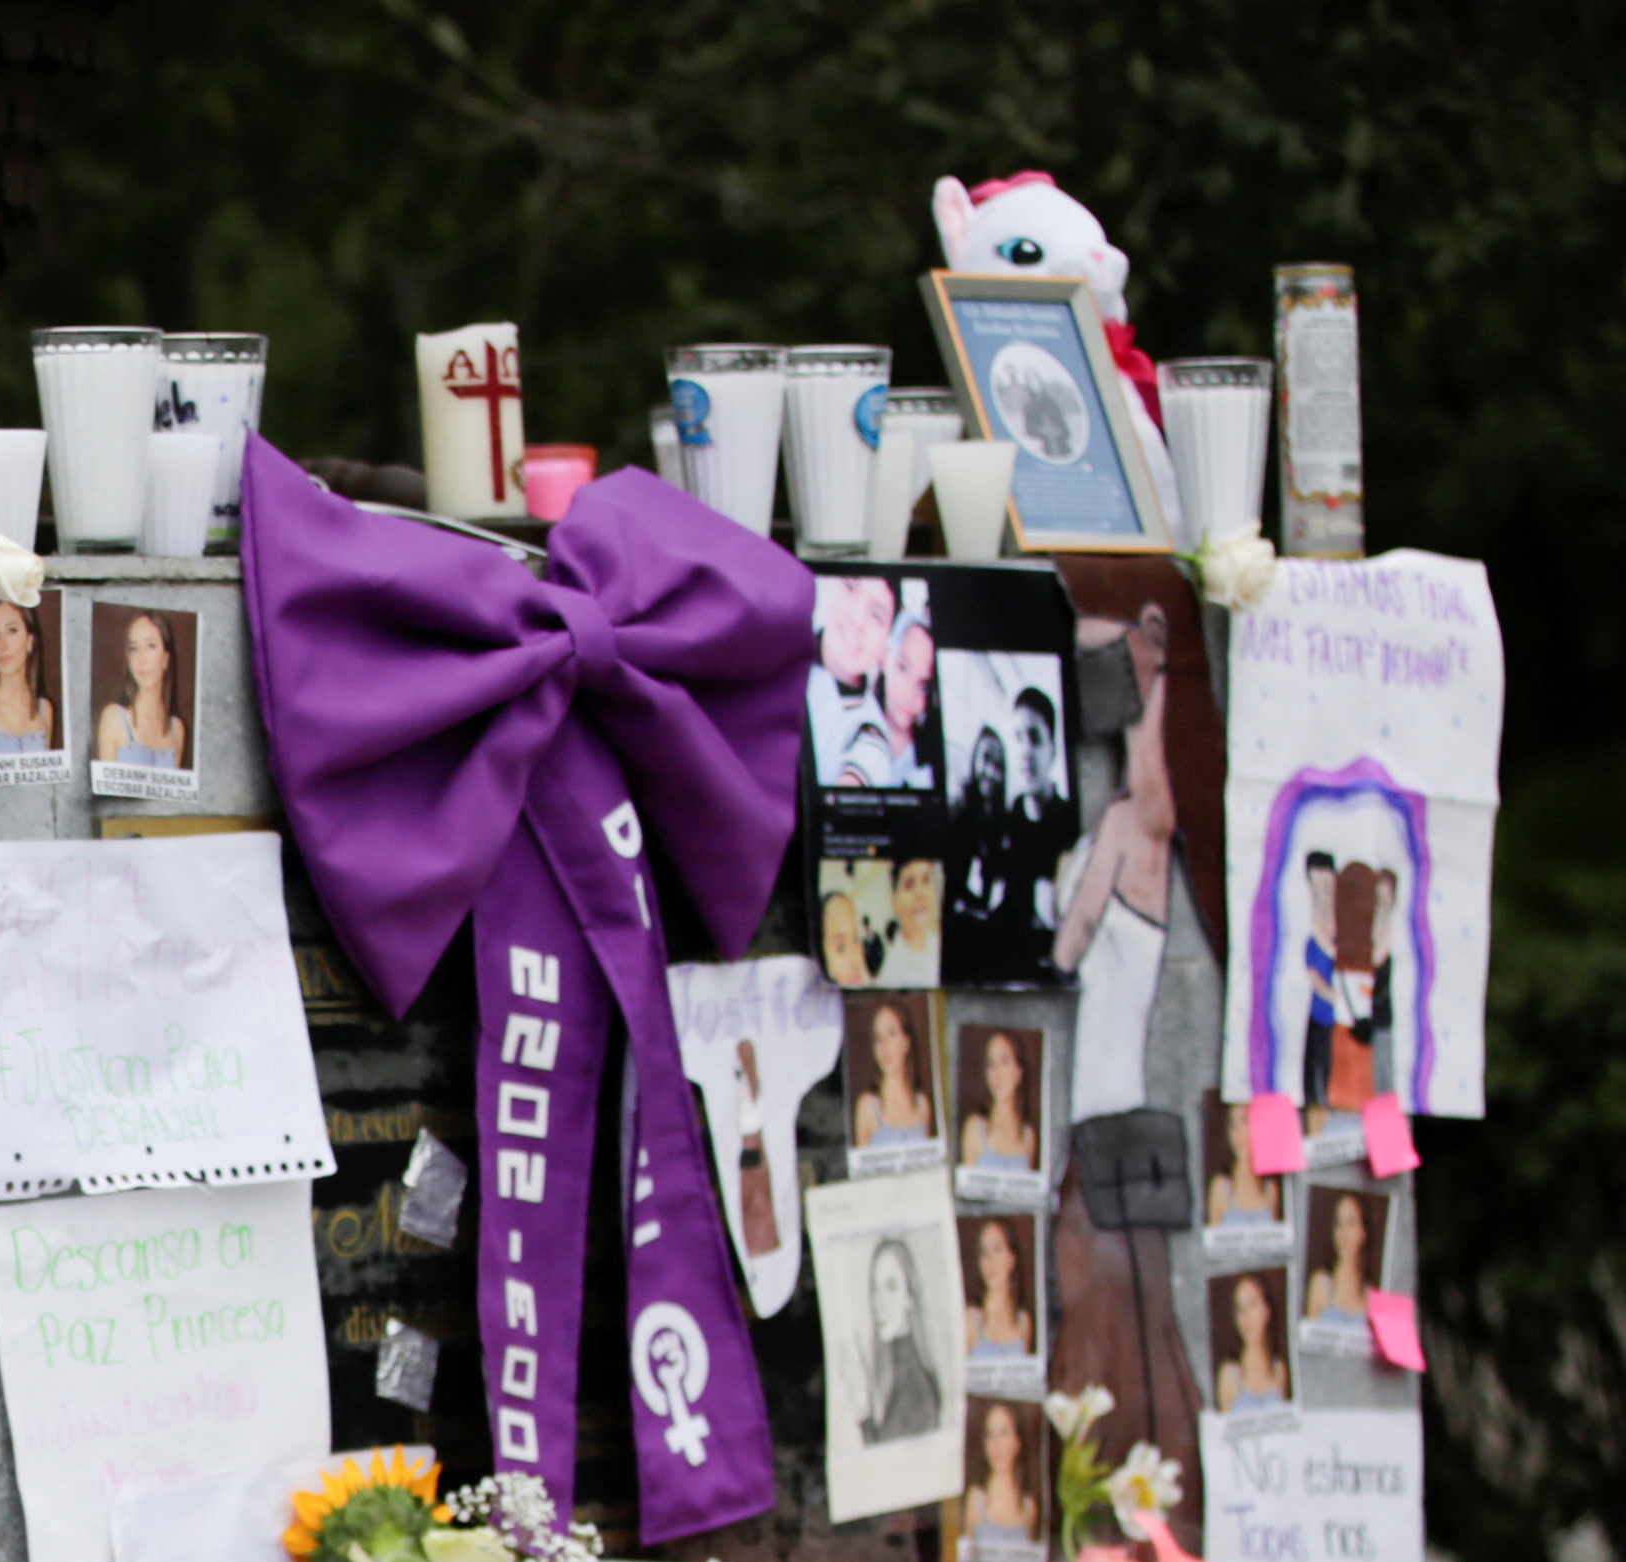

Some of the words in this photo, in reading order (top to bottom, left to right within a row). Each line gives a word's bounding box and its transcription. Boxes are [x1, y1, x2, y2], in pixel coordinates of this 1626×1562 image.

[14, 769, 71, 784] BAZALDUA
[19, 755, 64, 769] SUSANA
[96, 780, 146, 795] ESCOBAR
[150, 773, 192, 787] SUSANA
[63, 1101, 222, 1153] DEBANHI
[10, 1223, 203, 1294] Descansa
[218, 1222, 255, 1269] en
[143, 1293, 286, 1359] Princesa
[1230, 1438, 1288, 1495] No
